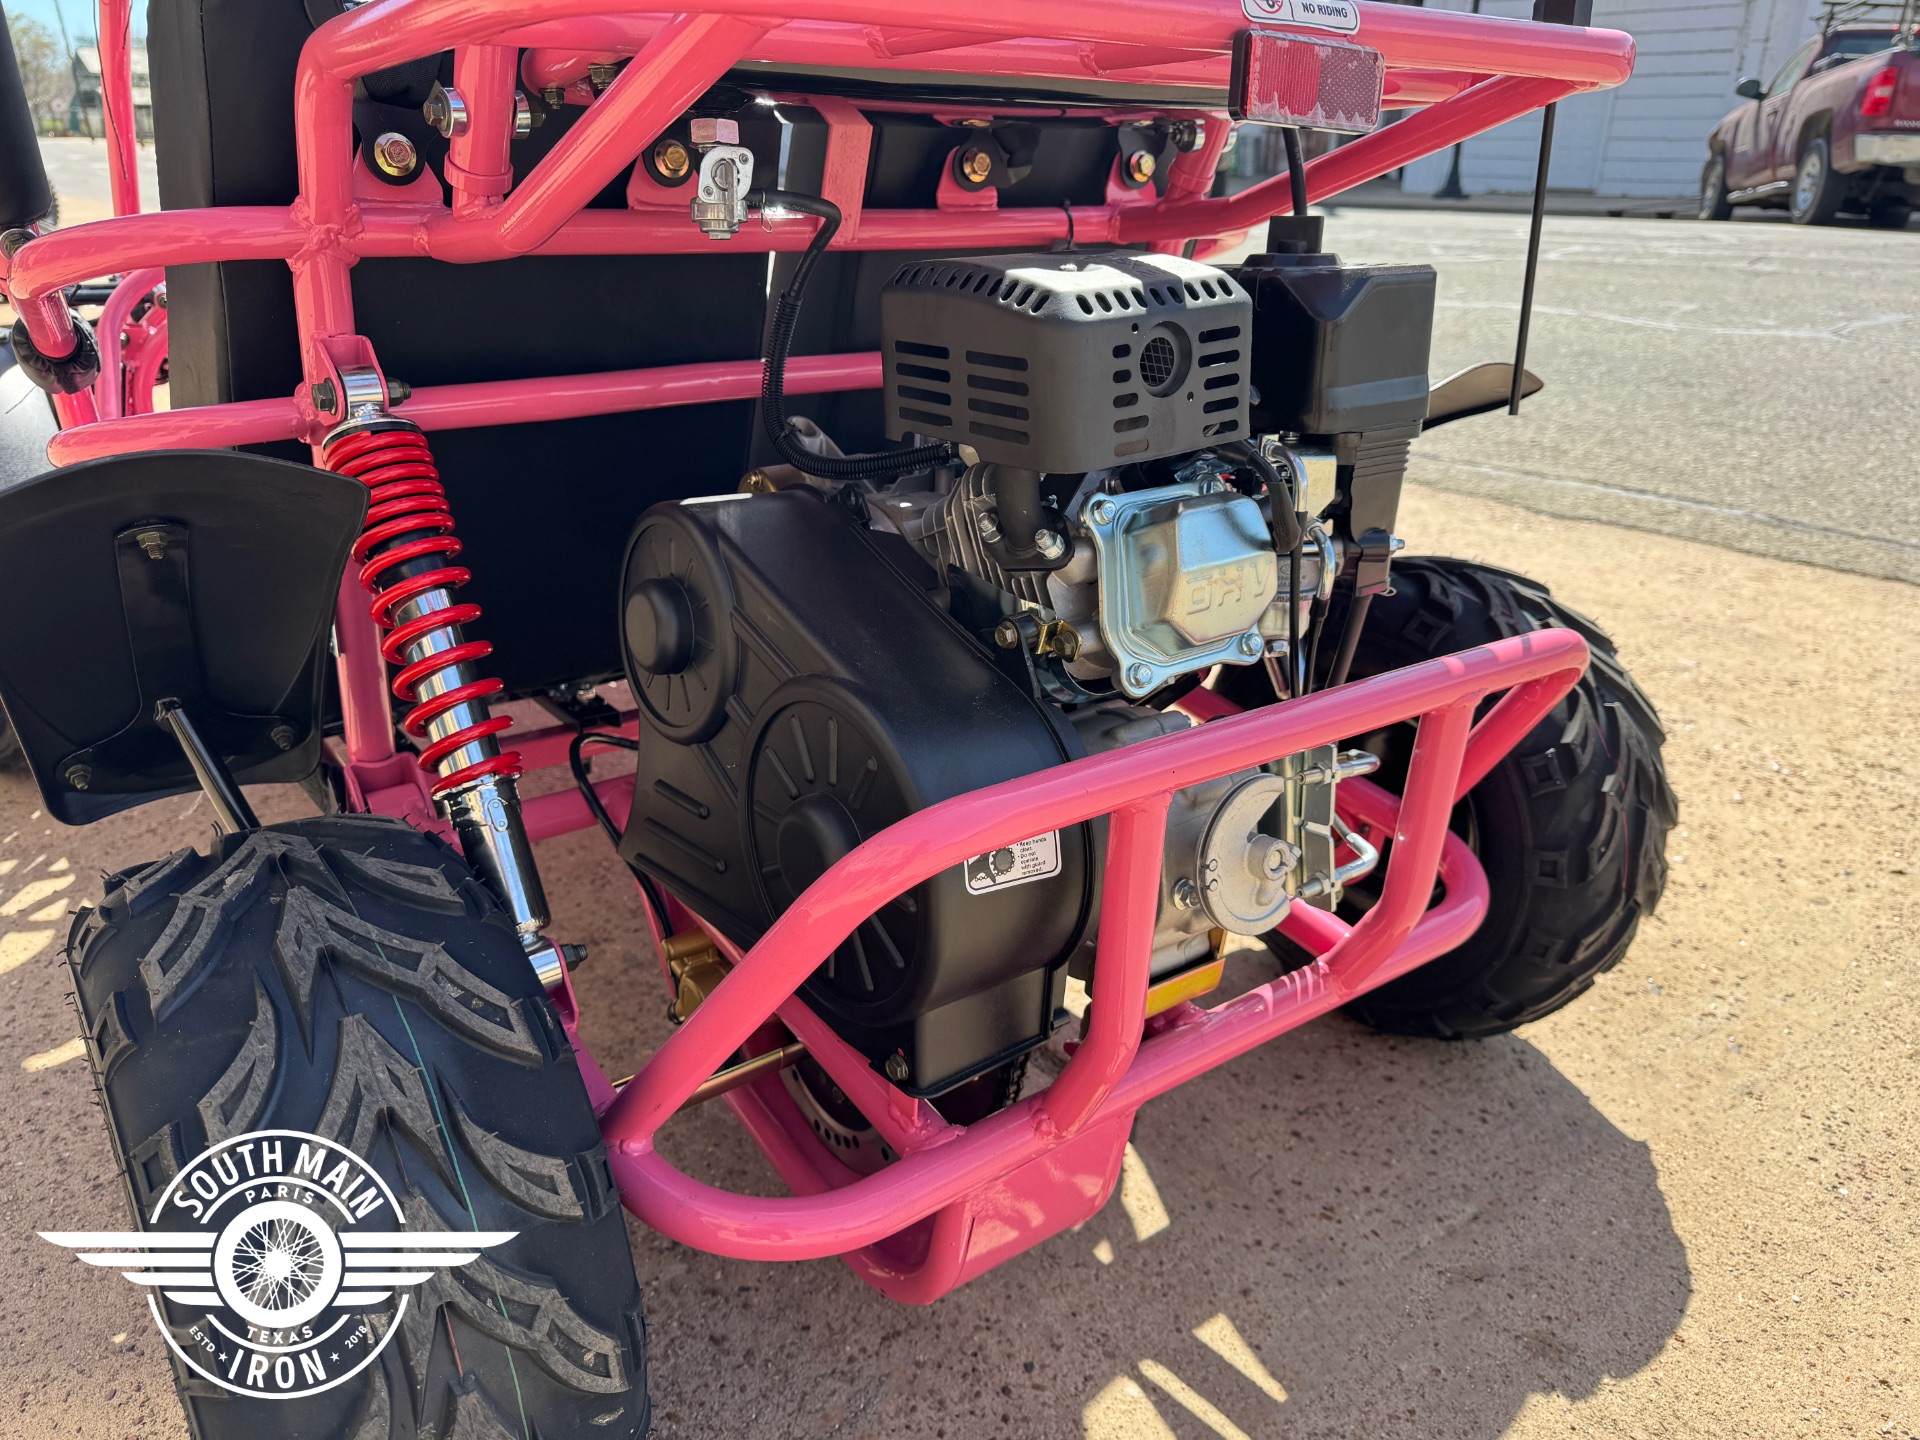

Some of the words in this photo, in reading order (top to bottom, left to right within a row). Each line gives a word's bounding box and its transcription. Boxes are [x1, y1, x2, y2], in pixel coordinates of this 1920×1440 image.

[1301, 3, 1315, 13] NO
[1317, 4, 1348, 18] RIDING
[1032, 860, 1045, 868] guard
